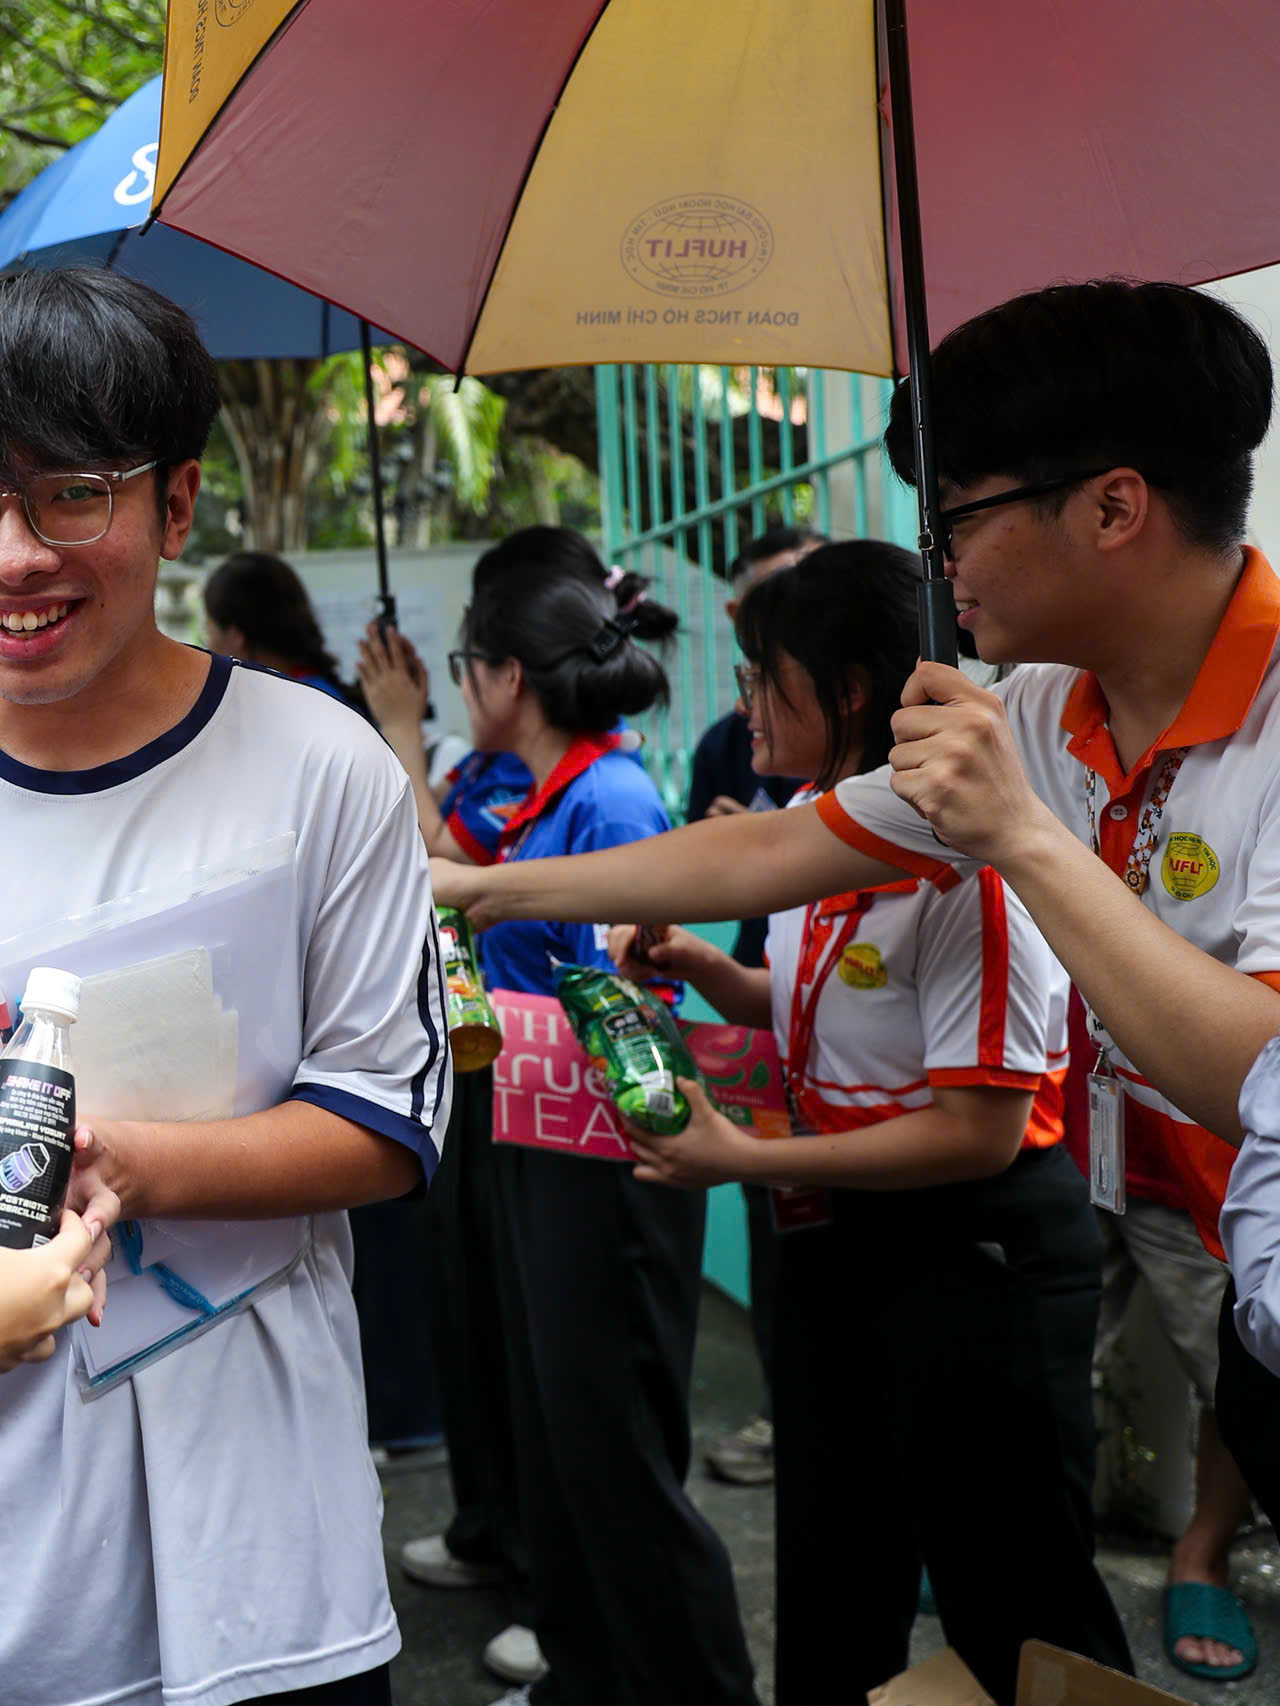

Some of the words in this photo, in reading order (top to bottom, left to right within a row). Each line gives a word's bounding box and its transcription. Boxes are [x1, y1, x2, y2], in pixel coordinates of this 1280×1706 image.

[5, 1075, 41, 1092] SHAKE
[41, 1082, 54, 1095] IT
[493, 1085, 628, 1152] TEA
[0, 1193, 50, 1214] POSTBIOTIC
